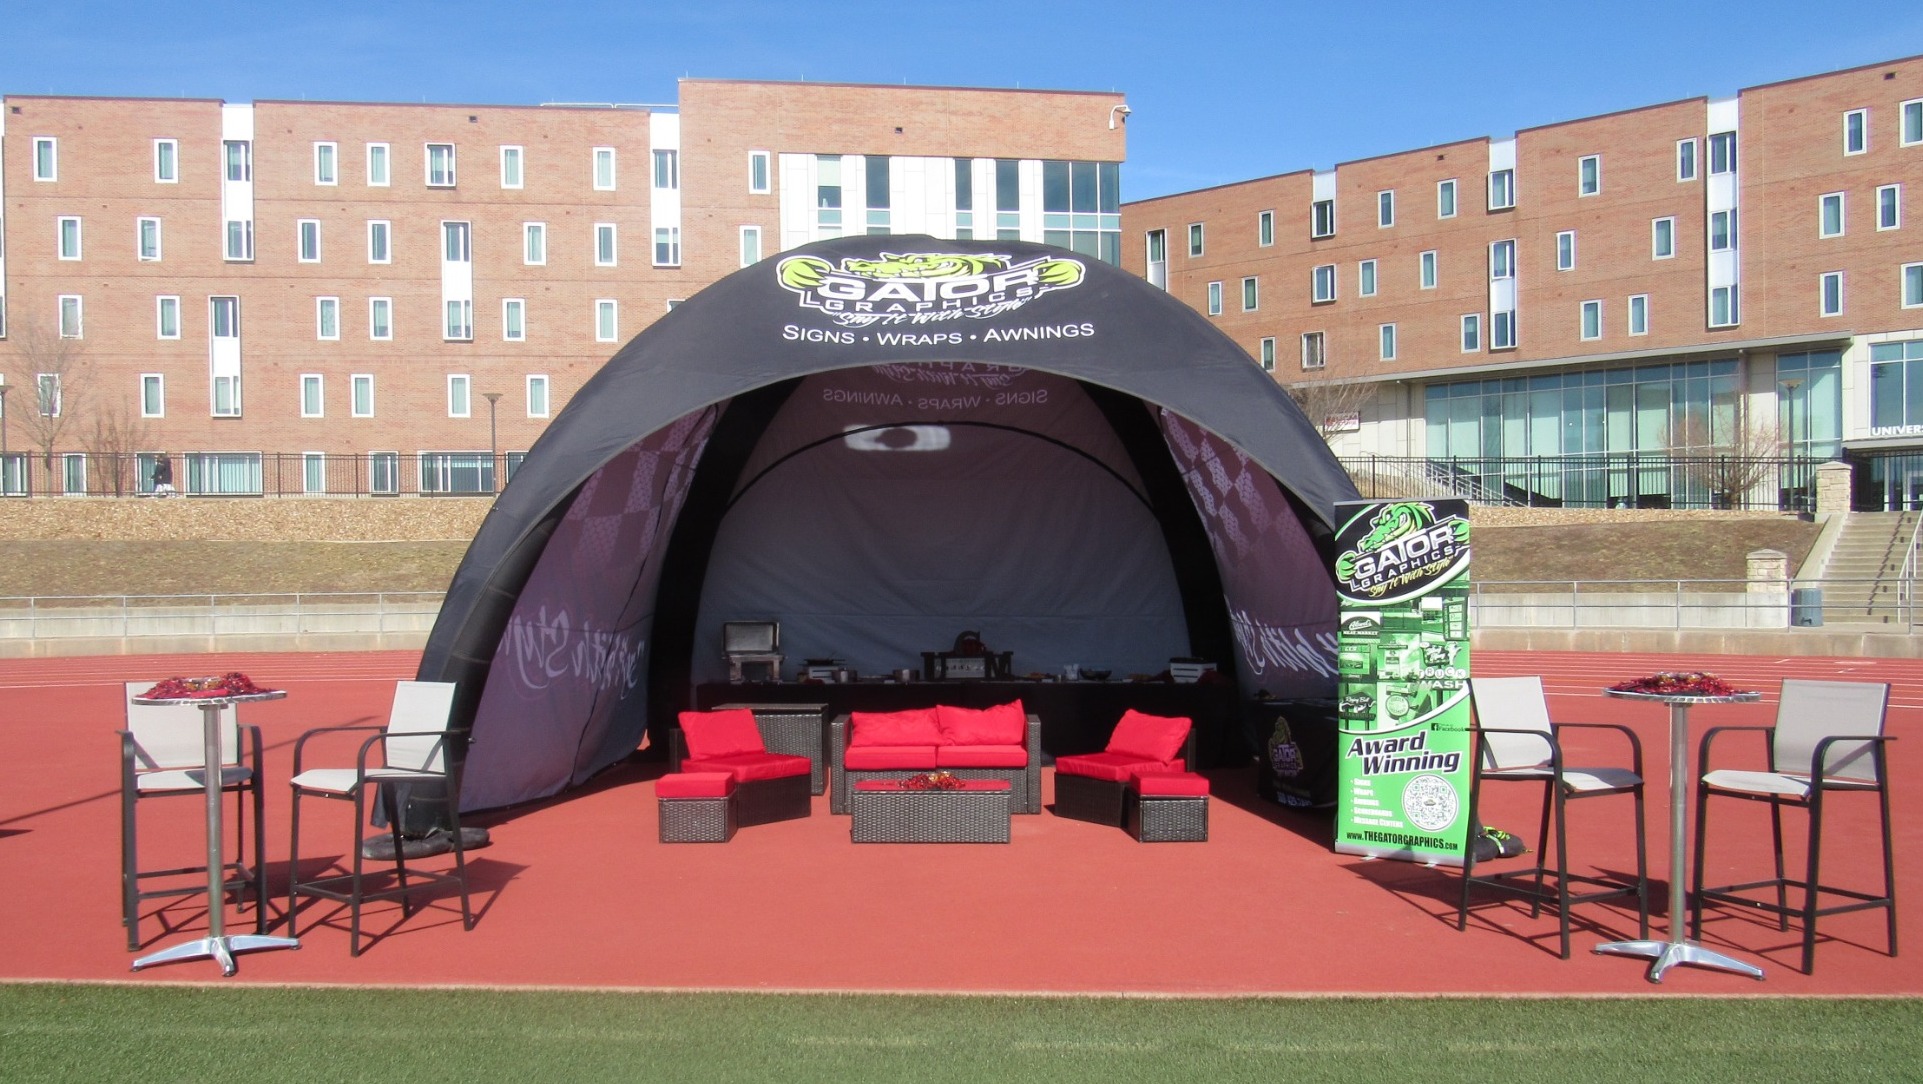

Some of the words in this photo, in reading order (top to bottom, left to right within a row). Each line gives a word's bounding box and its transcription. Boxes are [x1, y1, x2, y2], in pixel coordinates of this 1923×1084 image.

[817, 267, 1038, 303] GATOR
[825, 286, 1033, 313] GRAPHICS
[911, 307, 964, 325] With
[1355, 525, 1454, 580] GATOR
[1362, 546, 1454, 597] GRAPHICS
[1347, 731, 1426, 757] Award
[1363, 751, 1460, 775] Winning
